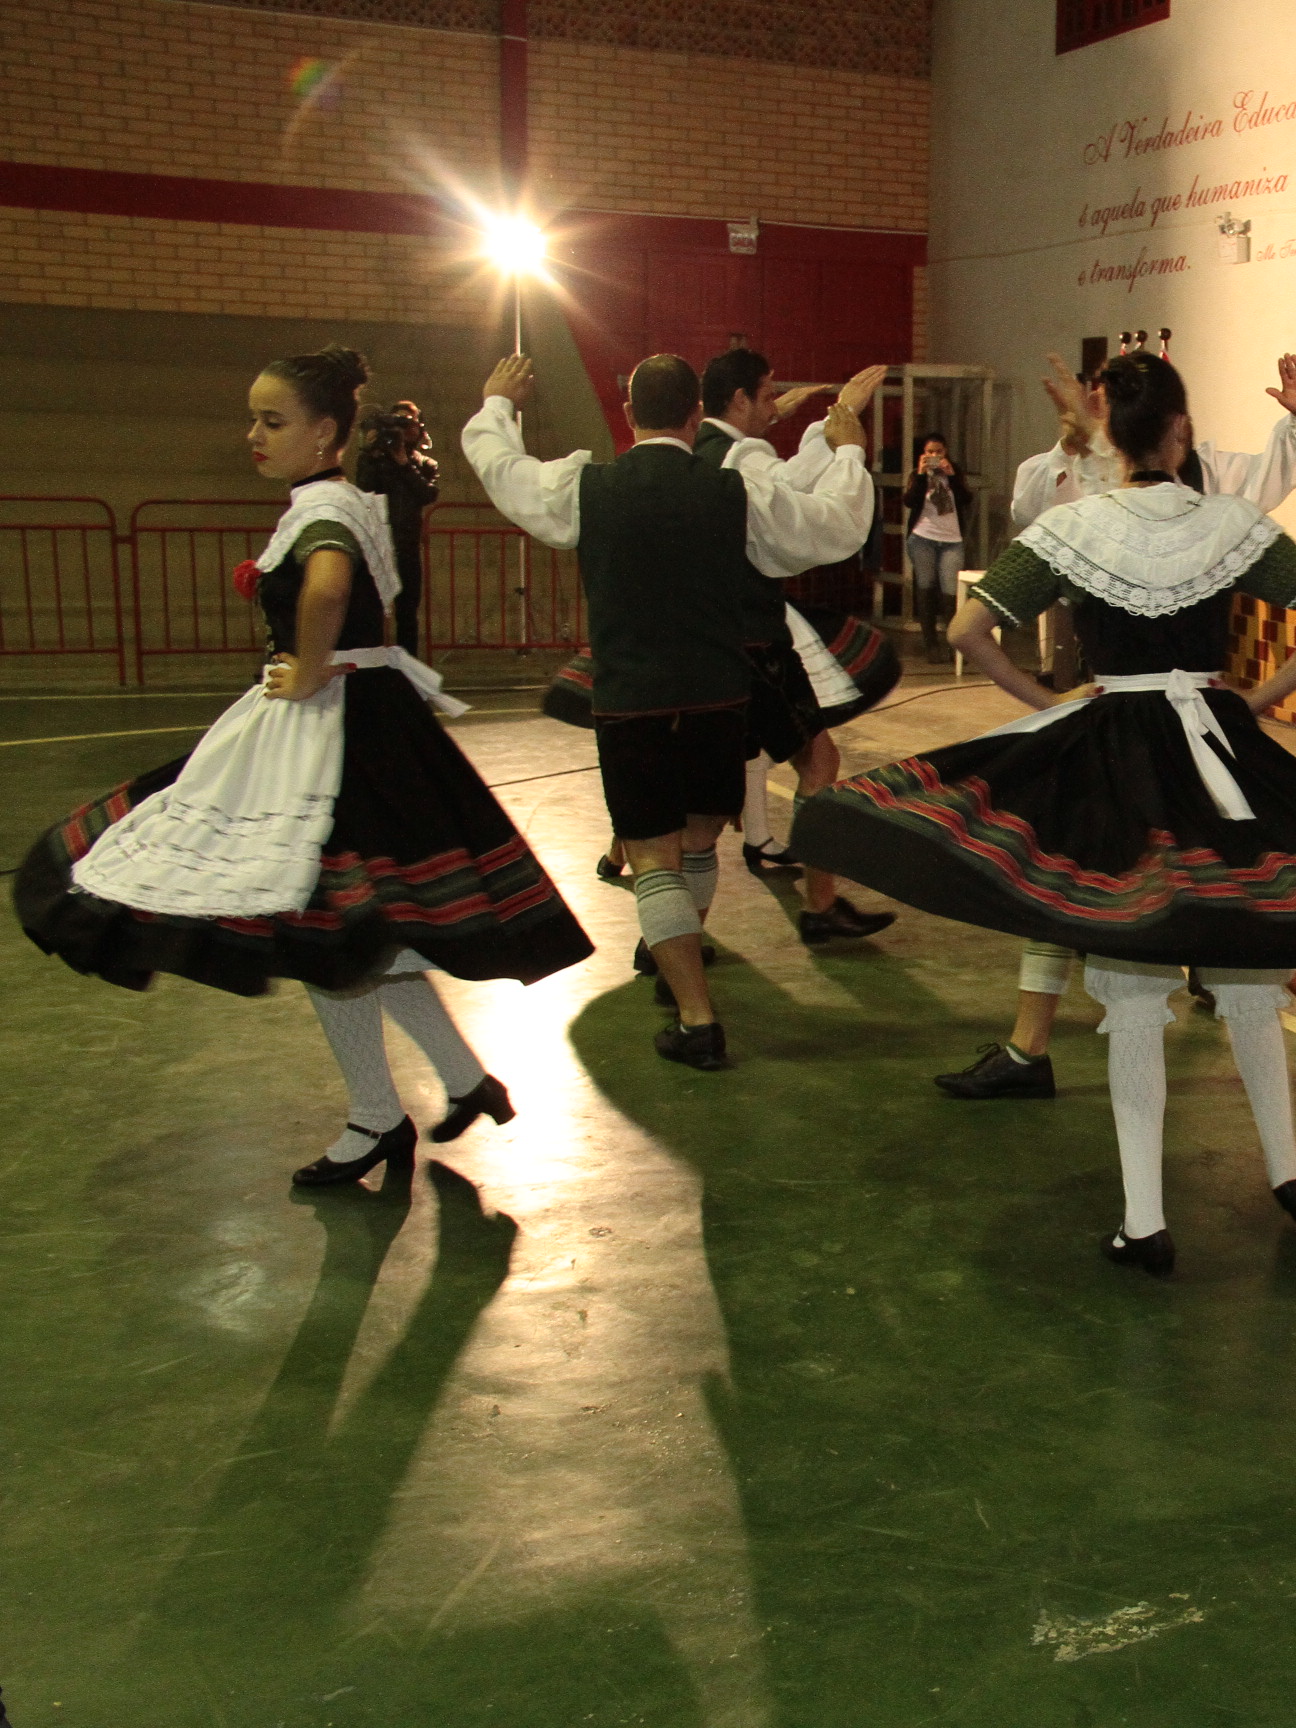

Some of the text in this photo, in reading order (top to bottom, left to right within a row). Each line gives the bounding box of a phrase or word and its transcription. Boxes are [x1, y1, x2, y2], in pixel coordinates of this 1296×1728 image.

[1083, 123, 1118, 166] A
[1119, 110, 1223, 159] Verdadeira
[1091, 186, 1147, 234] aquela
[1150, 193, 1182, 227] que
[1187, 166, 1289, 208] humaniza
[1090, 245, 1191, 293] transforma.
